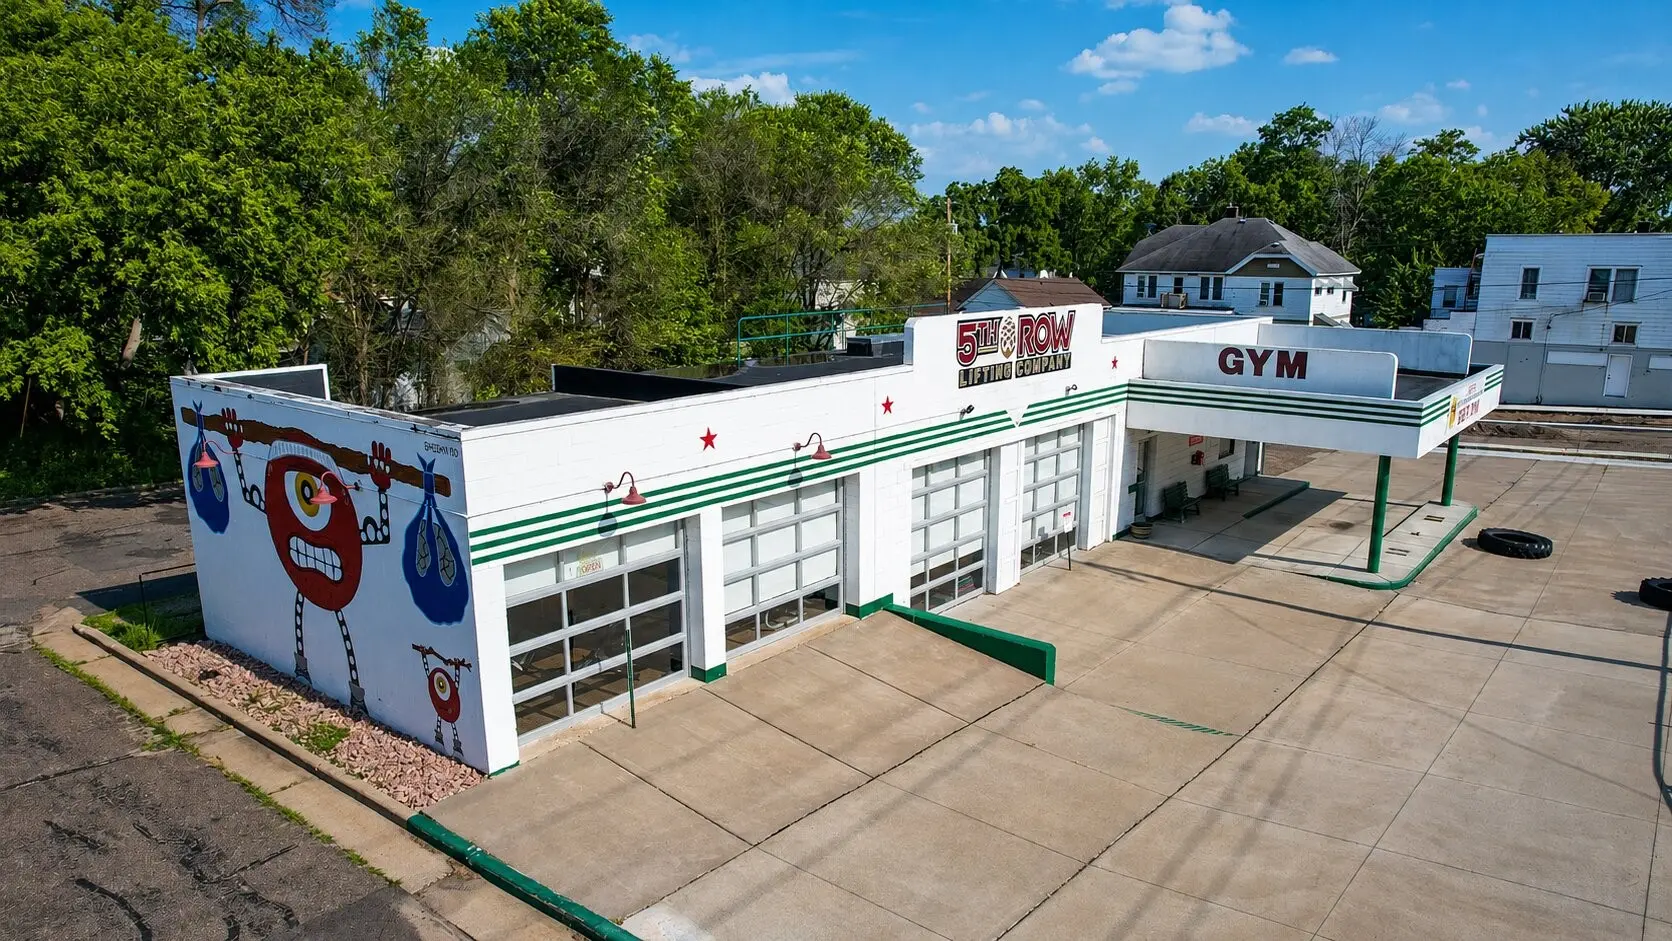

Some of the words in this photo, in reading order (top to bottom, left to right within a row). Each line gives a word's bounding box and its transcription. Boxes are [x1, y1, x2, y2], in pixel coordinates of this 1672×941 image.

[957, 316, 1002, 367] 5TH
[1016, 310, 1076, 358] ROW
[958, 362, 1012, 388] LIFTING
[1015, 352, 1071, 378] COMPANY
[1218, 346, 1308, 380] GYM
